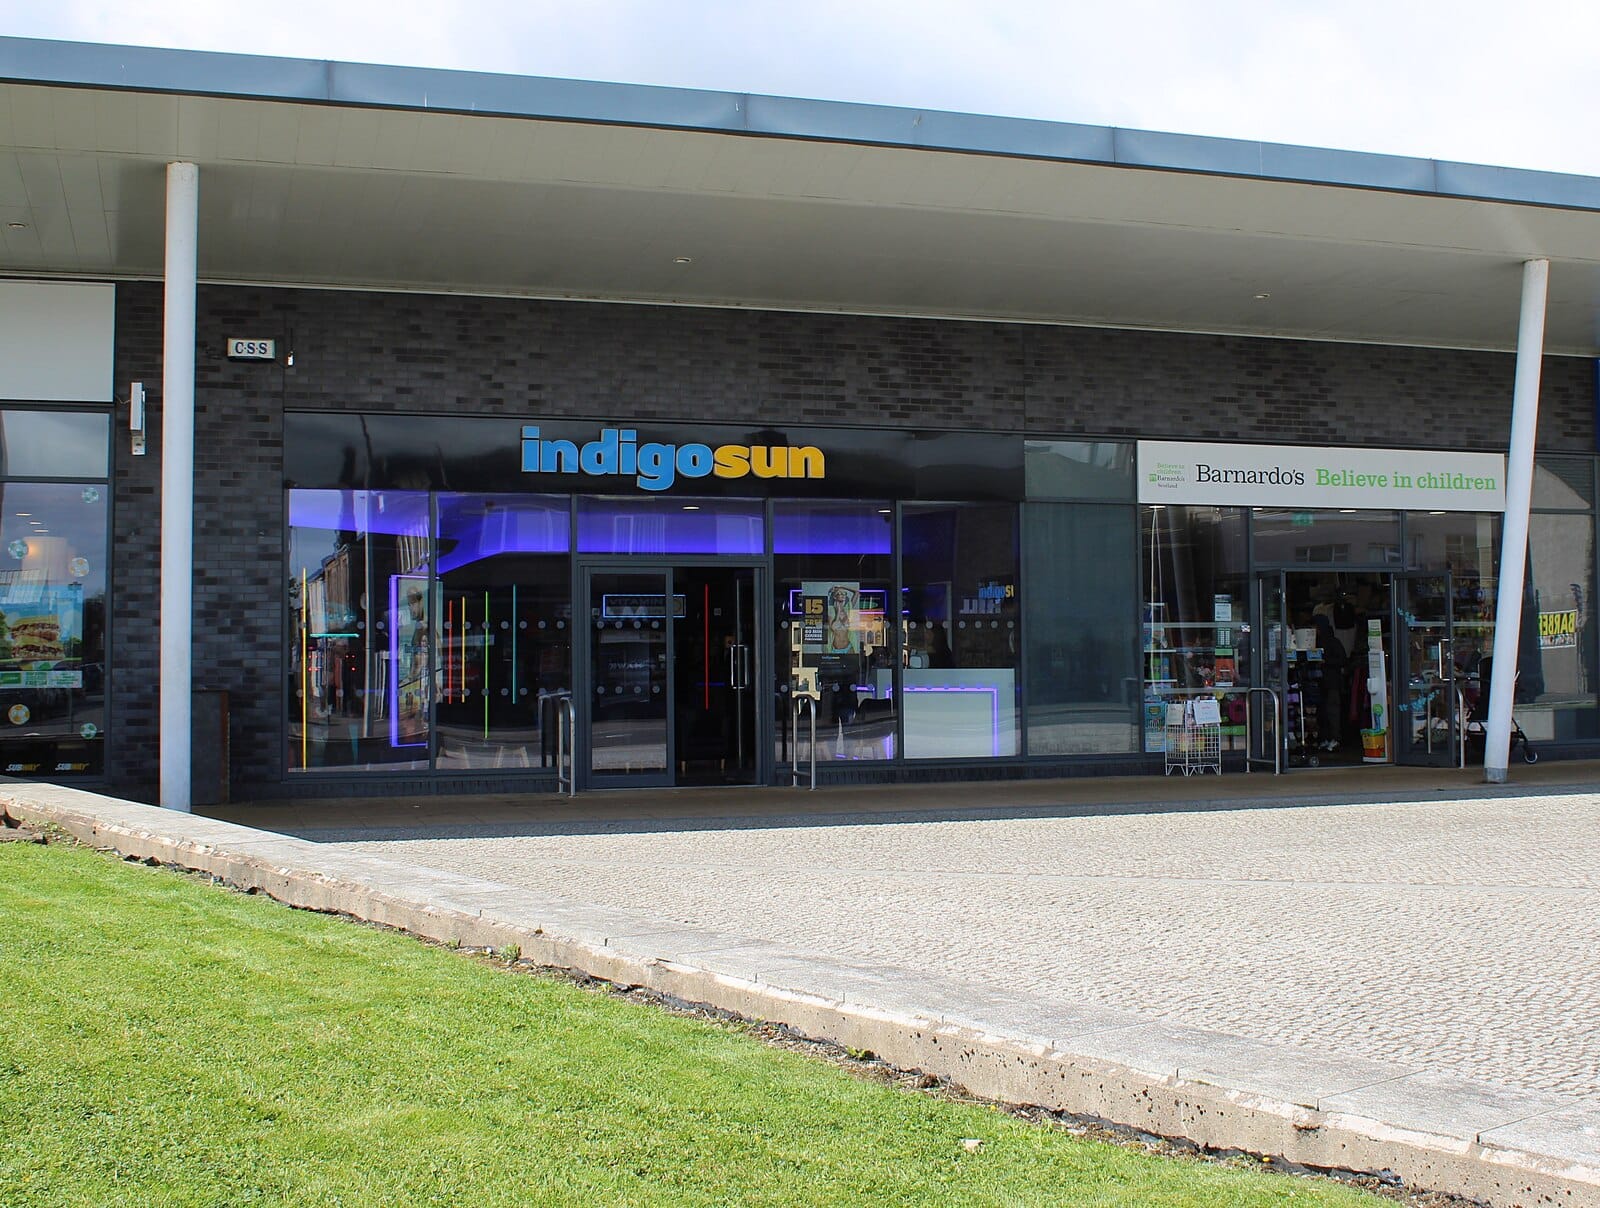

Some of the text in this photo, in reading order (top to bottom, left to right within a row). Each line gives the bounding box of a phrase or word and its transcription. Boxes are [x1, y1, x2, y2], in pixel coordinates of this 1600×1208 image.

[520, 425, 825, 491] indigosun
[1195, 464, 1497, 490] Barnardo's Believe in children
[805, 598, 824, 615] 15
